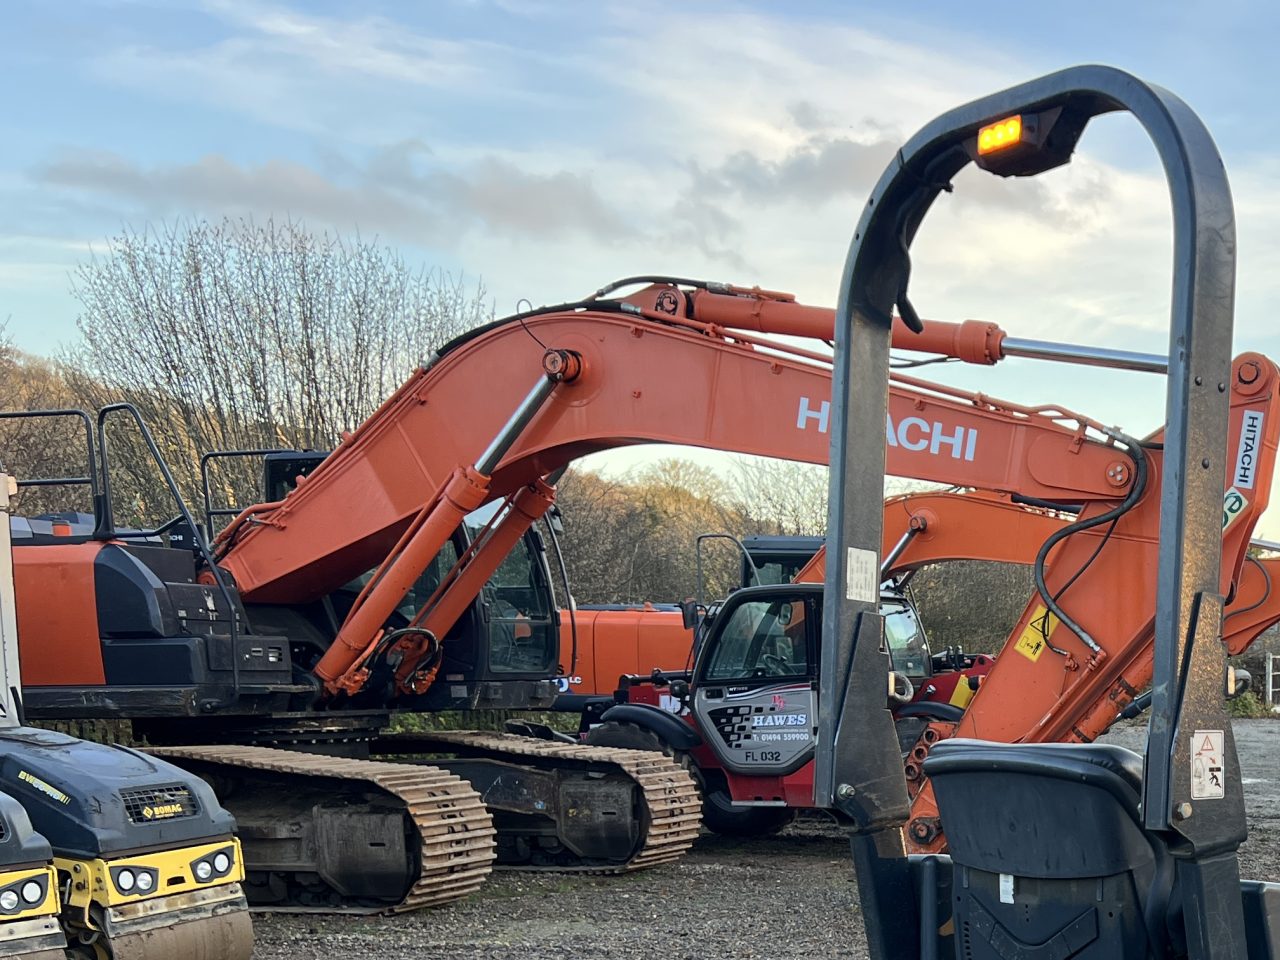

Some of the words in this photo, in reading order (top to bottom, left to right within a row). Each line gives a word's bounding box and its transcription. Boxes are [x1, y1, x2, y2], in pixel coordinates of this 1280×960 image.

[797, 397, 978, 461] HCHI
[1238, 415, 1259, 484] HITACHI
[752, 714, 808, 727] HAWES
[761, 733, 781, 741] 01494
[783, 733, 809, 741] 559900
[745, 752, 758, 762] FL
[761, 752, 781, 762] 032
[153, 803, 183, 815] BOMAG
